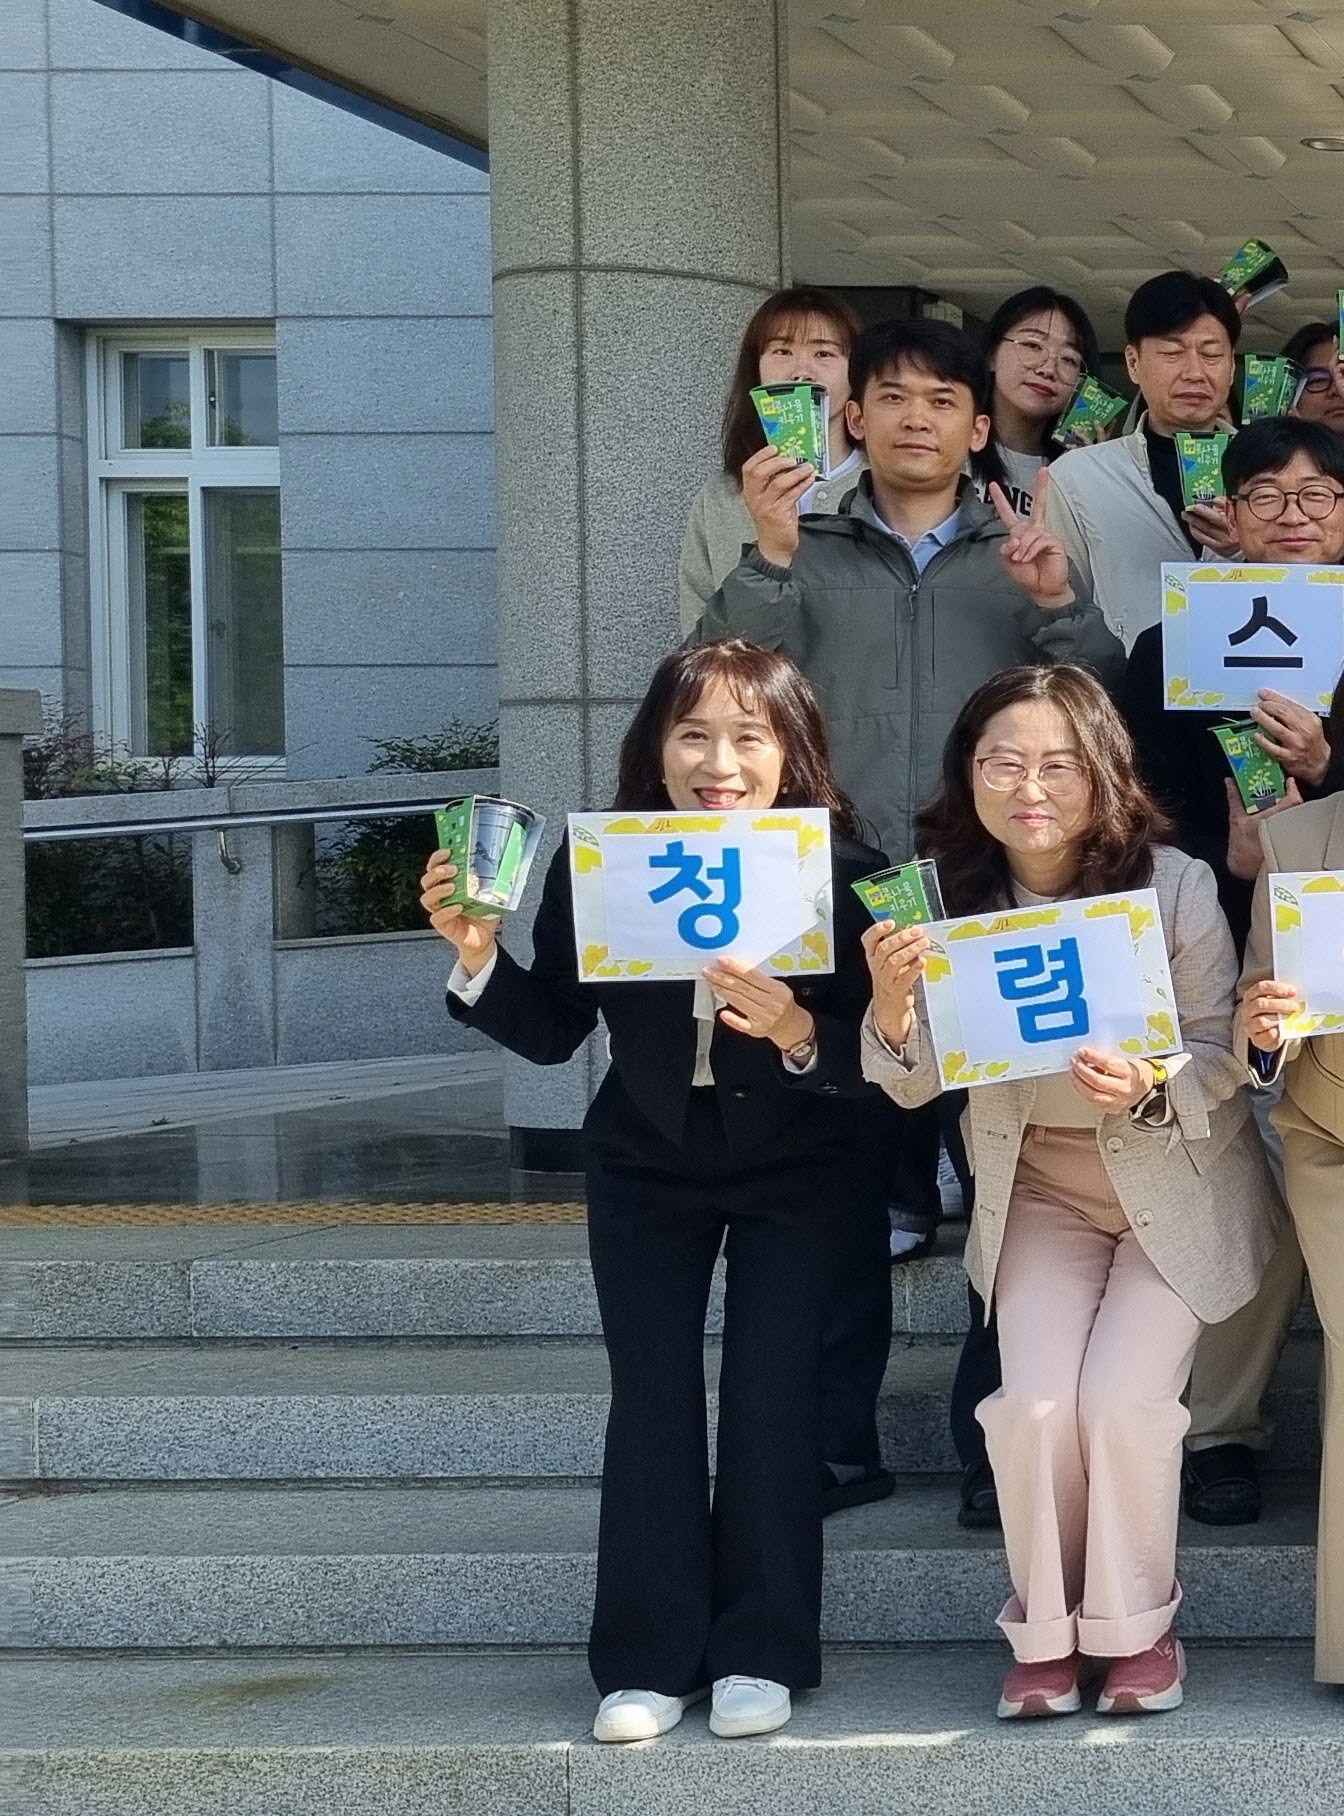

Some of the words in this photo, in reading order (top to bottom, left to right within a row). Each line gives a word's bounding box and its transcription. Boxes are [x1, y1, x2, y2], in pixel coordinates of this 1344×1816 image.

[1224, 597, 1302, 668] 스
[648, 841, 742, 949] 청
[995, 938, 1089, 1043] 렴
